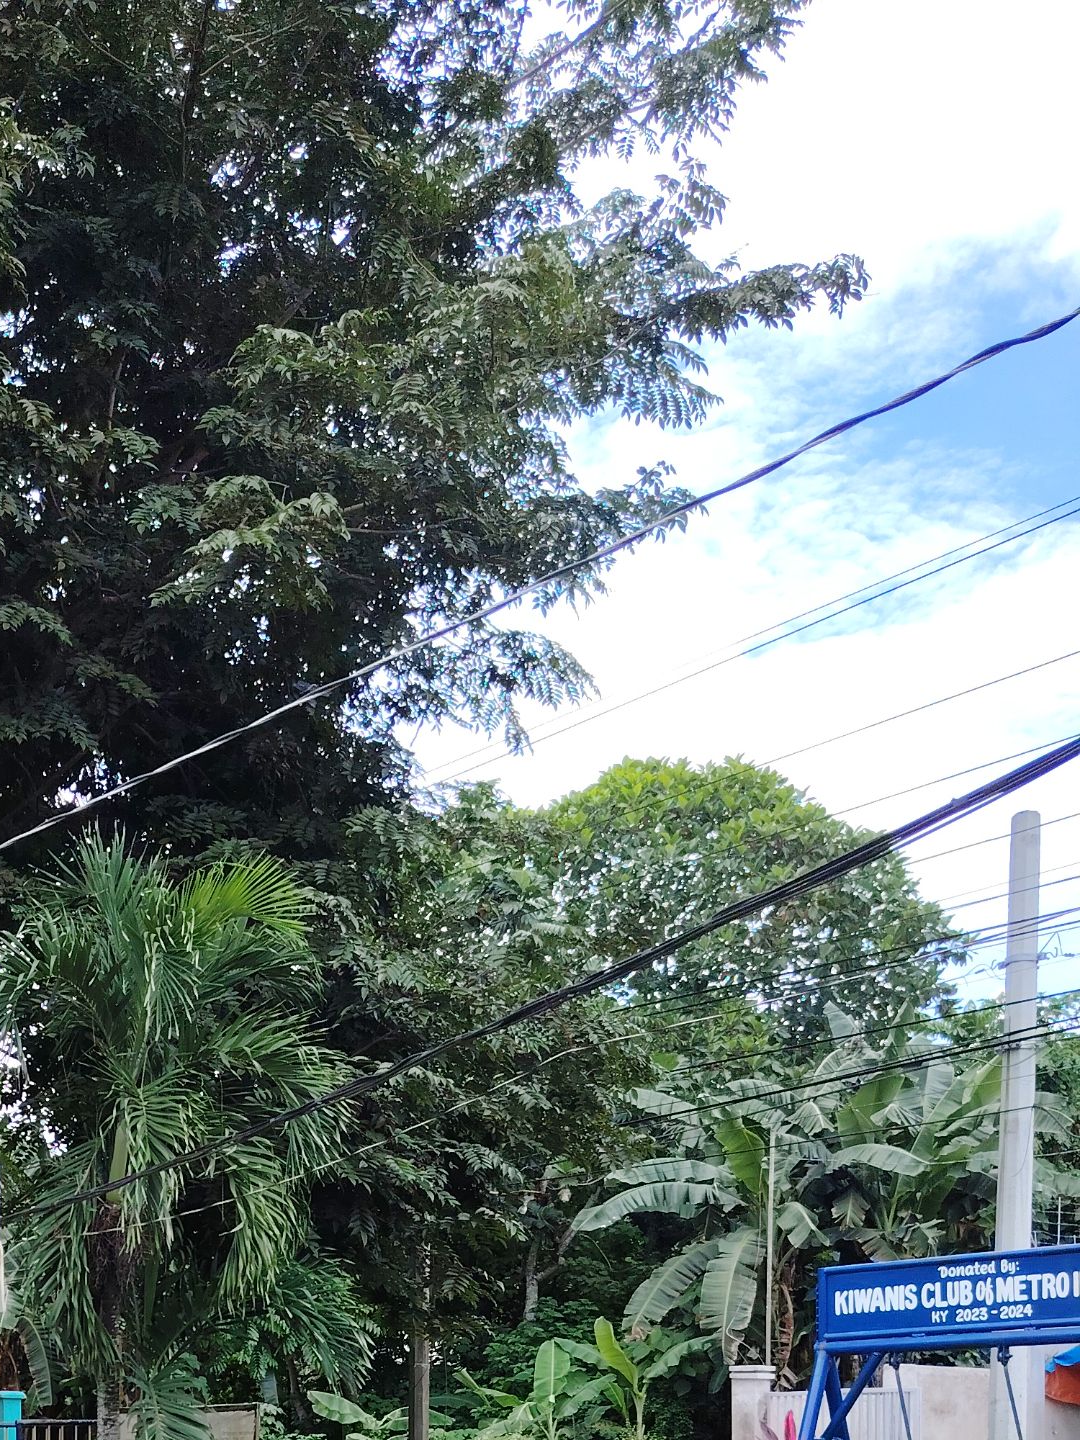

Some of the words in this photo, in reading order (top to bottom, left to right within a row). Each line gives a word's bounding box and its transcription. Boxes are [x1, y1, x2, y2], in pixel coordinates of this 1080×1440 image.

[937, 1261, 996, 1279] Donated
[1001, 1259, 1020, 1275] By:
[834, 1284, 918, 1316] KIWANIS
[921, 1280, 974, 1309] CLUB
[996, 1271, 1070, 1303] METRO
